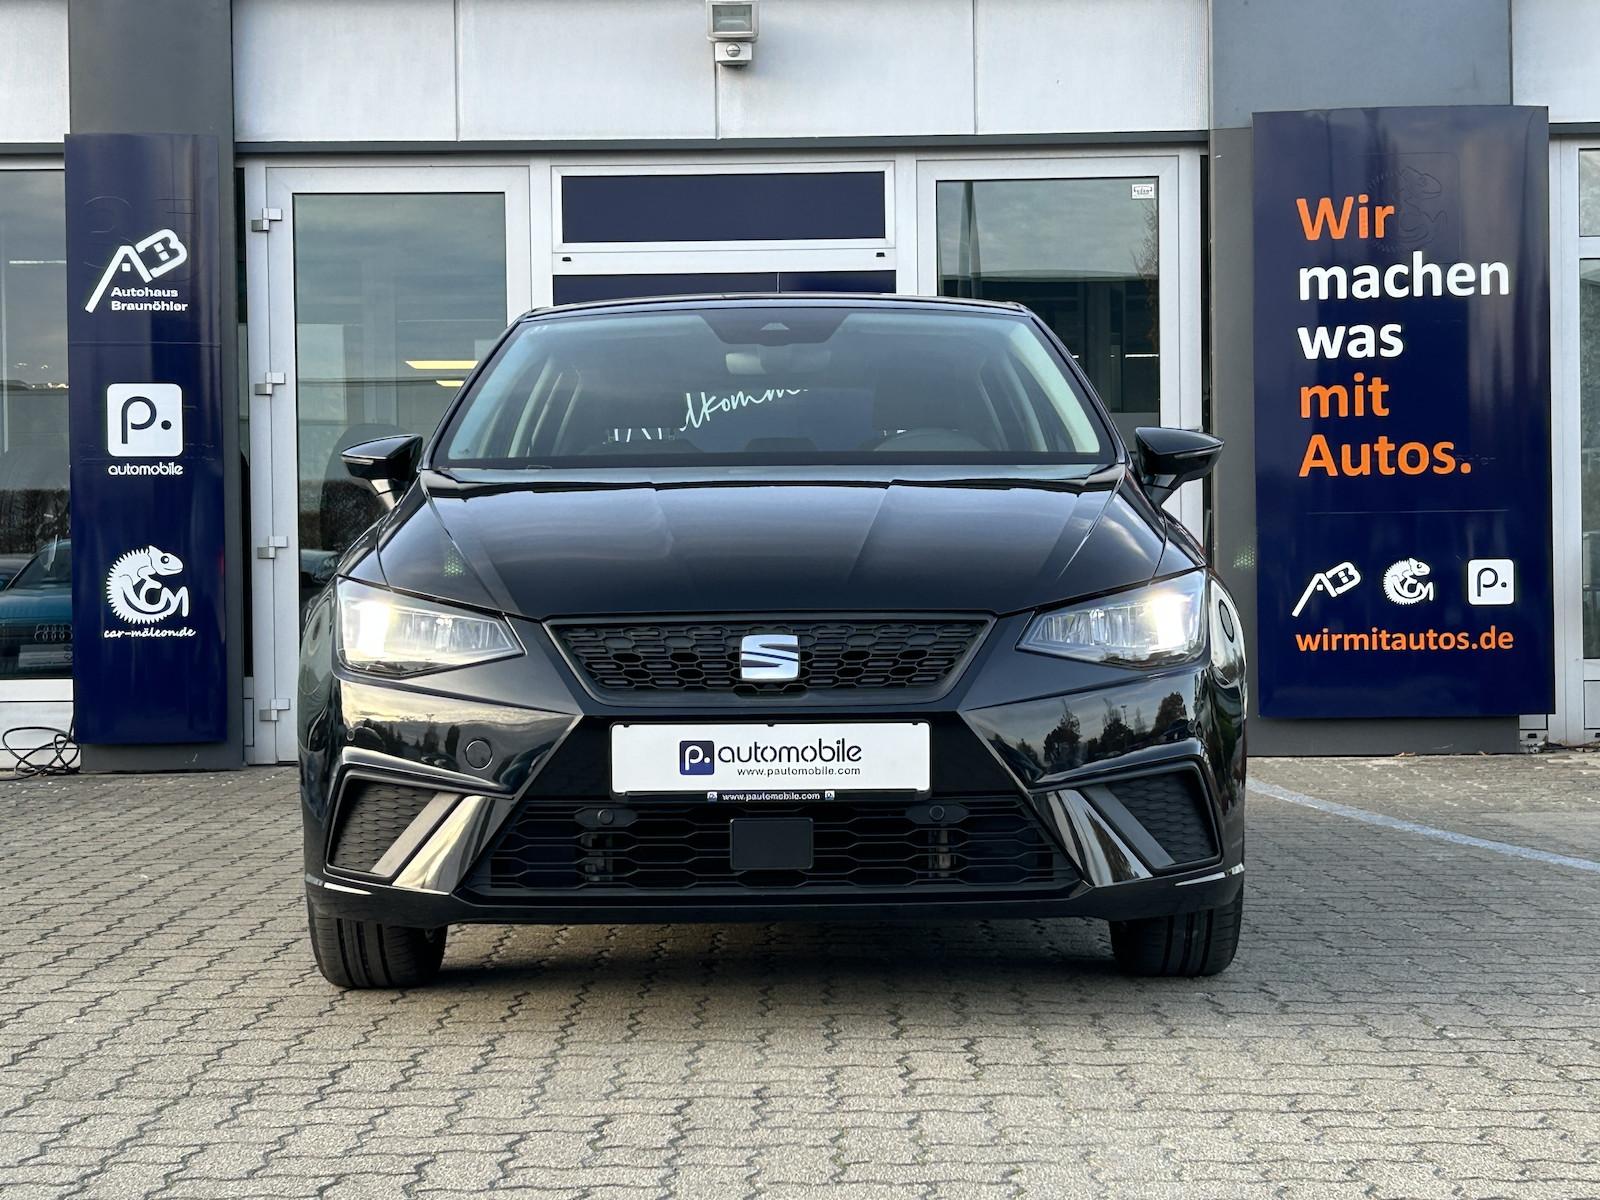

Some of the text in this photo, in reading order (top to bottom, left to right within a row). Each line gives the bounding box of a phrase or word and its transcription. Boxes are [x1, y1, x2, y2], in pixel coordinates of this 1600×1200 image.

[1296, 194, 1394, 241] Wir
[1299, 250, 1509, 301] machen
[111, 286, 179, 298] Autohaus
[111, 300, 189, 312] Braunöhler
[1297, 322, 1404, 360] was
[1300, 372, 1390, 419] mit
[107, 461, 184, 476] automobile
[1298, 433, 1472, 478] Autos.
[1295, 624, 1515, 652] wirmitautos.de
[717, 737, 862, 764] automobile
[737, 766, 862, 778] www.pautomobile.com
[722, 791, 821, 802] www.pautomobile.com
